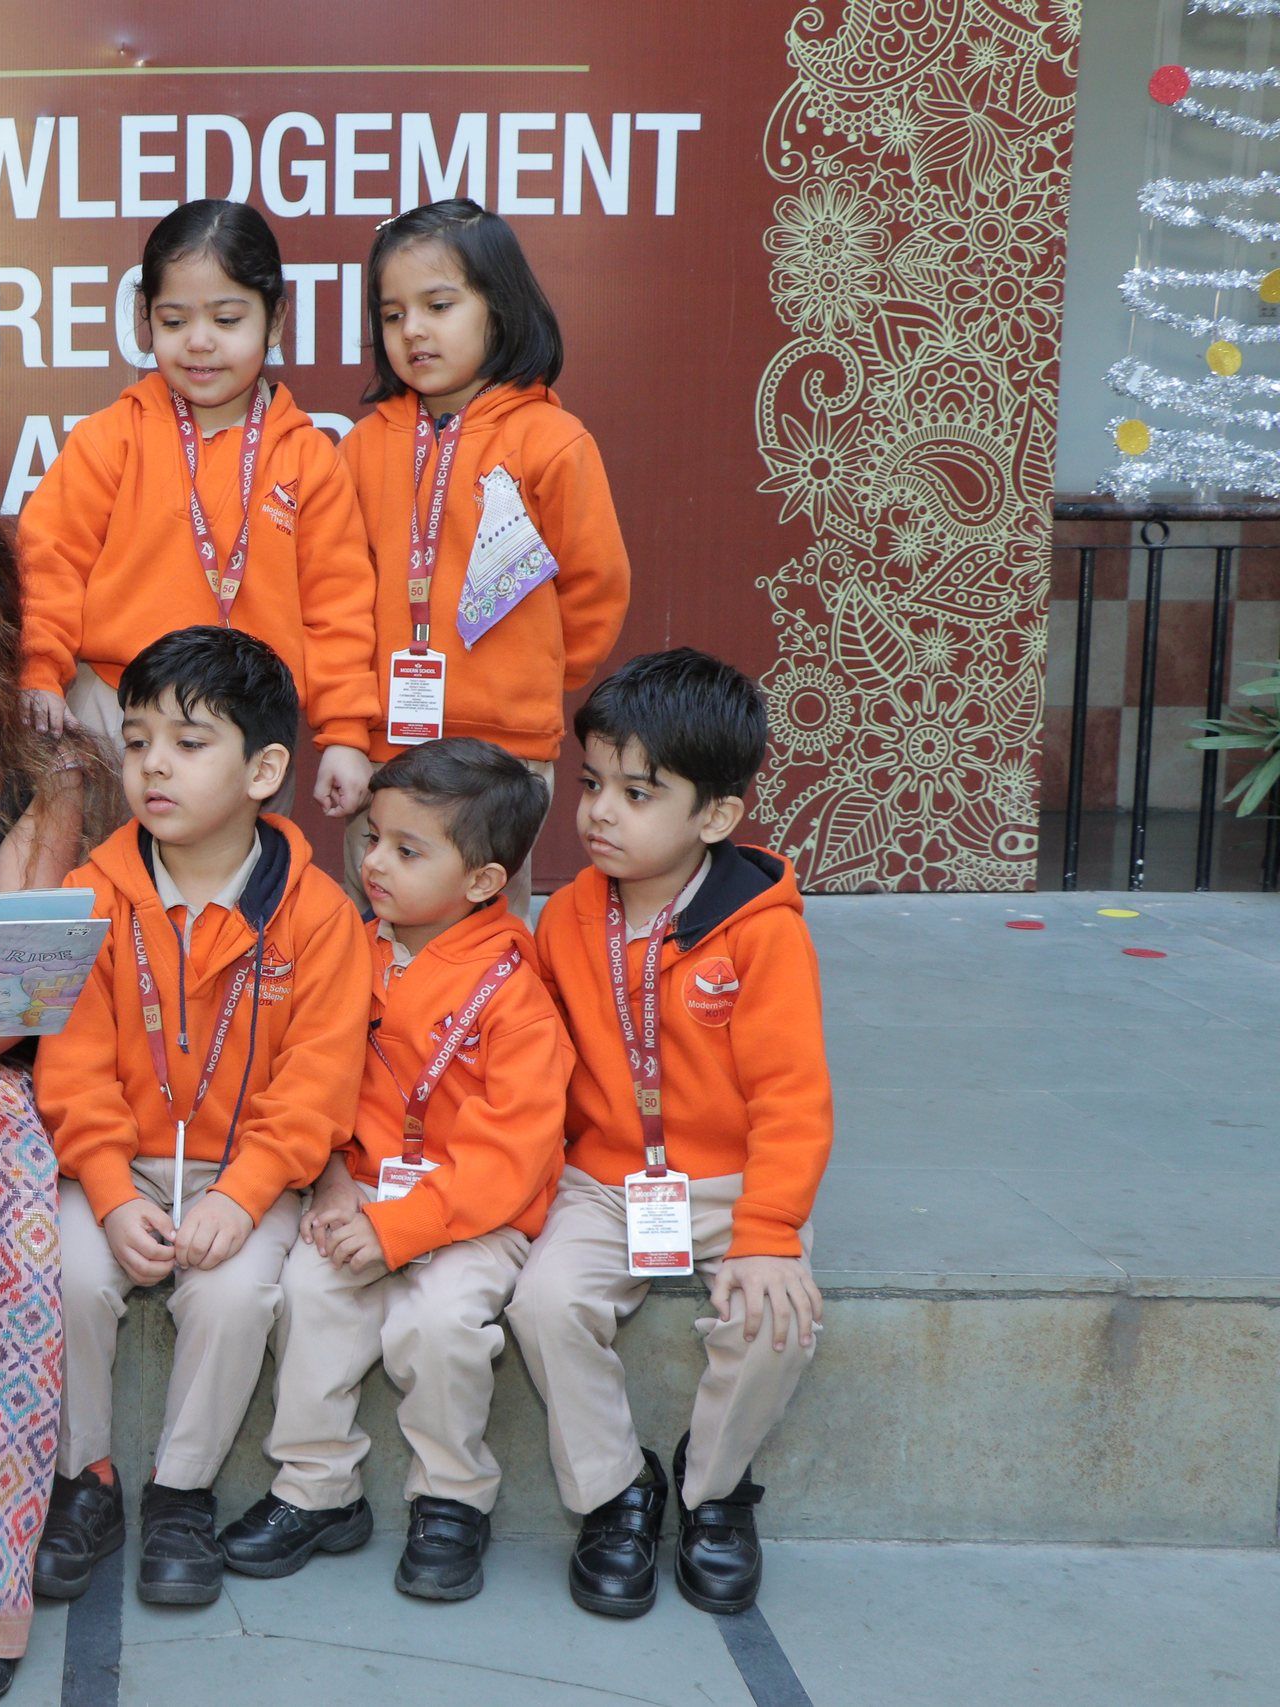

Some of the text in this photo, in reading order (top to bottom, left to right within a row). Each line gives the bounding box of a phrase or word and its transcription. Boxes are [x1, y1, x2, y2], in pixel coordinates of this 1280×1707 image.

[242, 449, 255, 497] SCHOOL
[428, 439, 455, 540] MODERN SCHOOL
[222, 584, 235, 593] 50
[410, 586, 424, 596] 50
[6, 949, 73, 963] RIDE
[610, 932, 635, 1041] MODERN SCHOOL
[644, 937, 659, 1049] MODERN SCHOOL
[259, 998, 273, 1006] OTA
[688, 1000, 718, 1009] Modern
[145, 1013, 158, 1024] 50
[206, 965, 250, 1074] MODERN SCHOOL
[428, 980, 496, 1078] MODERN SCHOOL
[644, 1097, 658, 1108] 50
